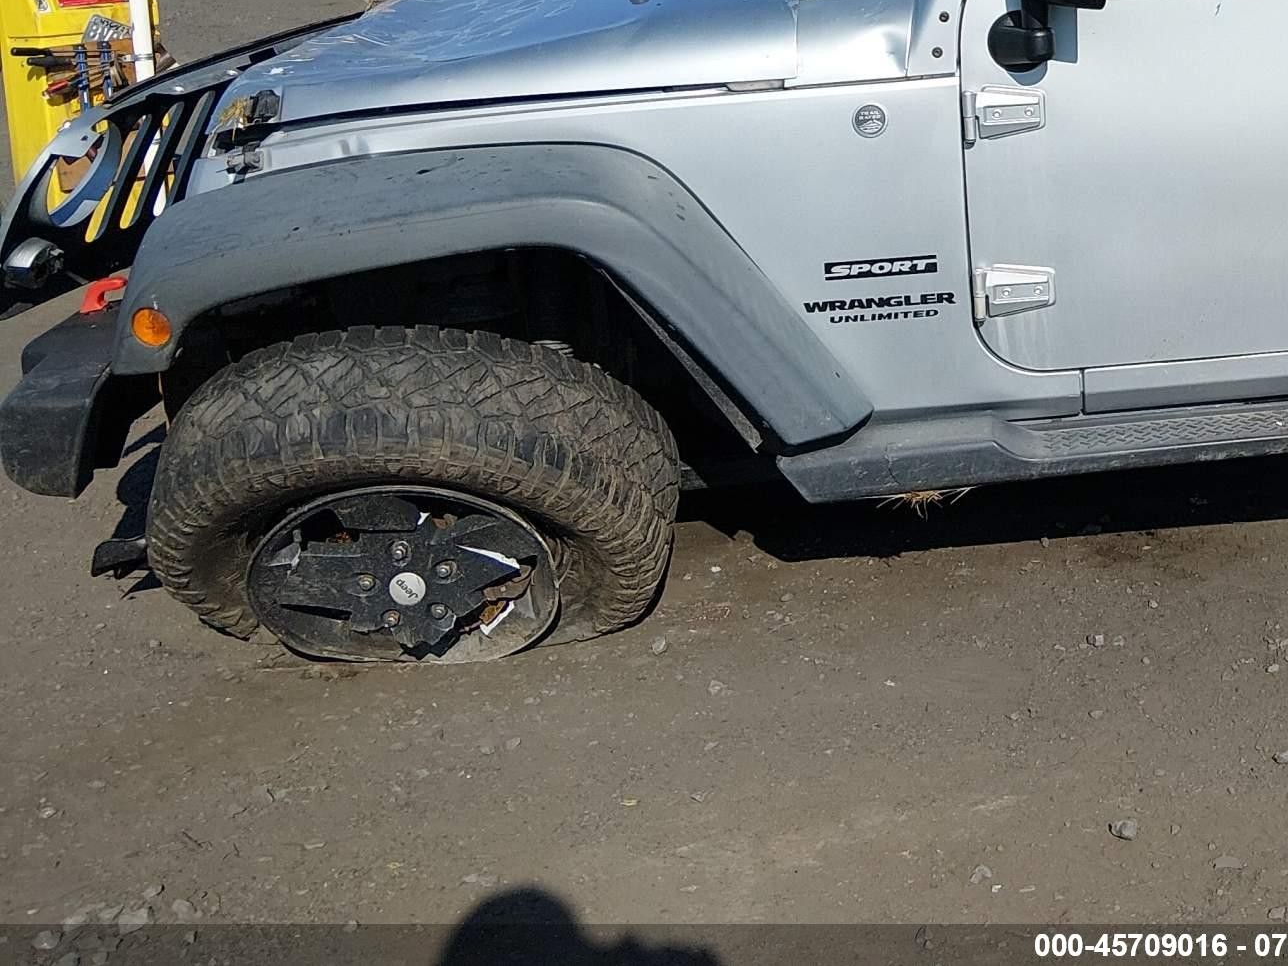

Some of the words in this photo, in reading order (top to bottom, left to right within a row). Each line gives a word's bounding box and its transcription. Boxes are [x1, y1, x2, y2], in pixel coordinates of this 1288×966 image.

[825, 256, 937, 280] SPORT
[803, 292, 957, 314] WRANGLER
[830, 309, 940, 324] UNLIMITED
[396, 579, 419, 599] Jeep
